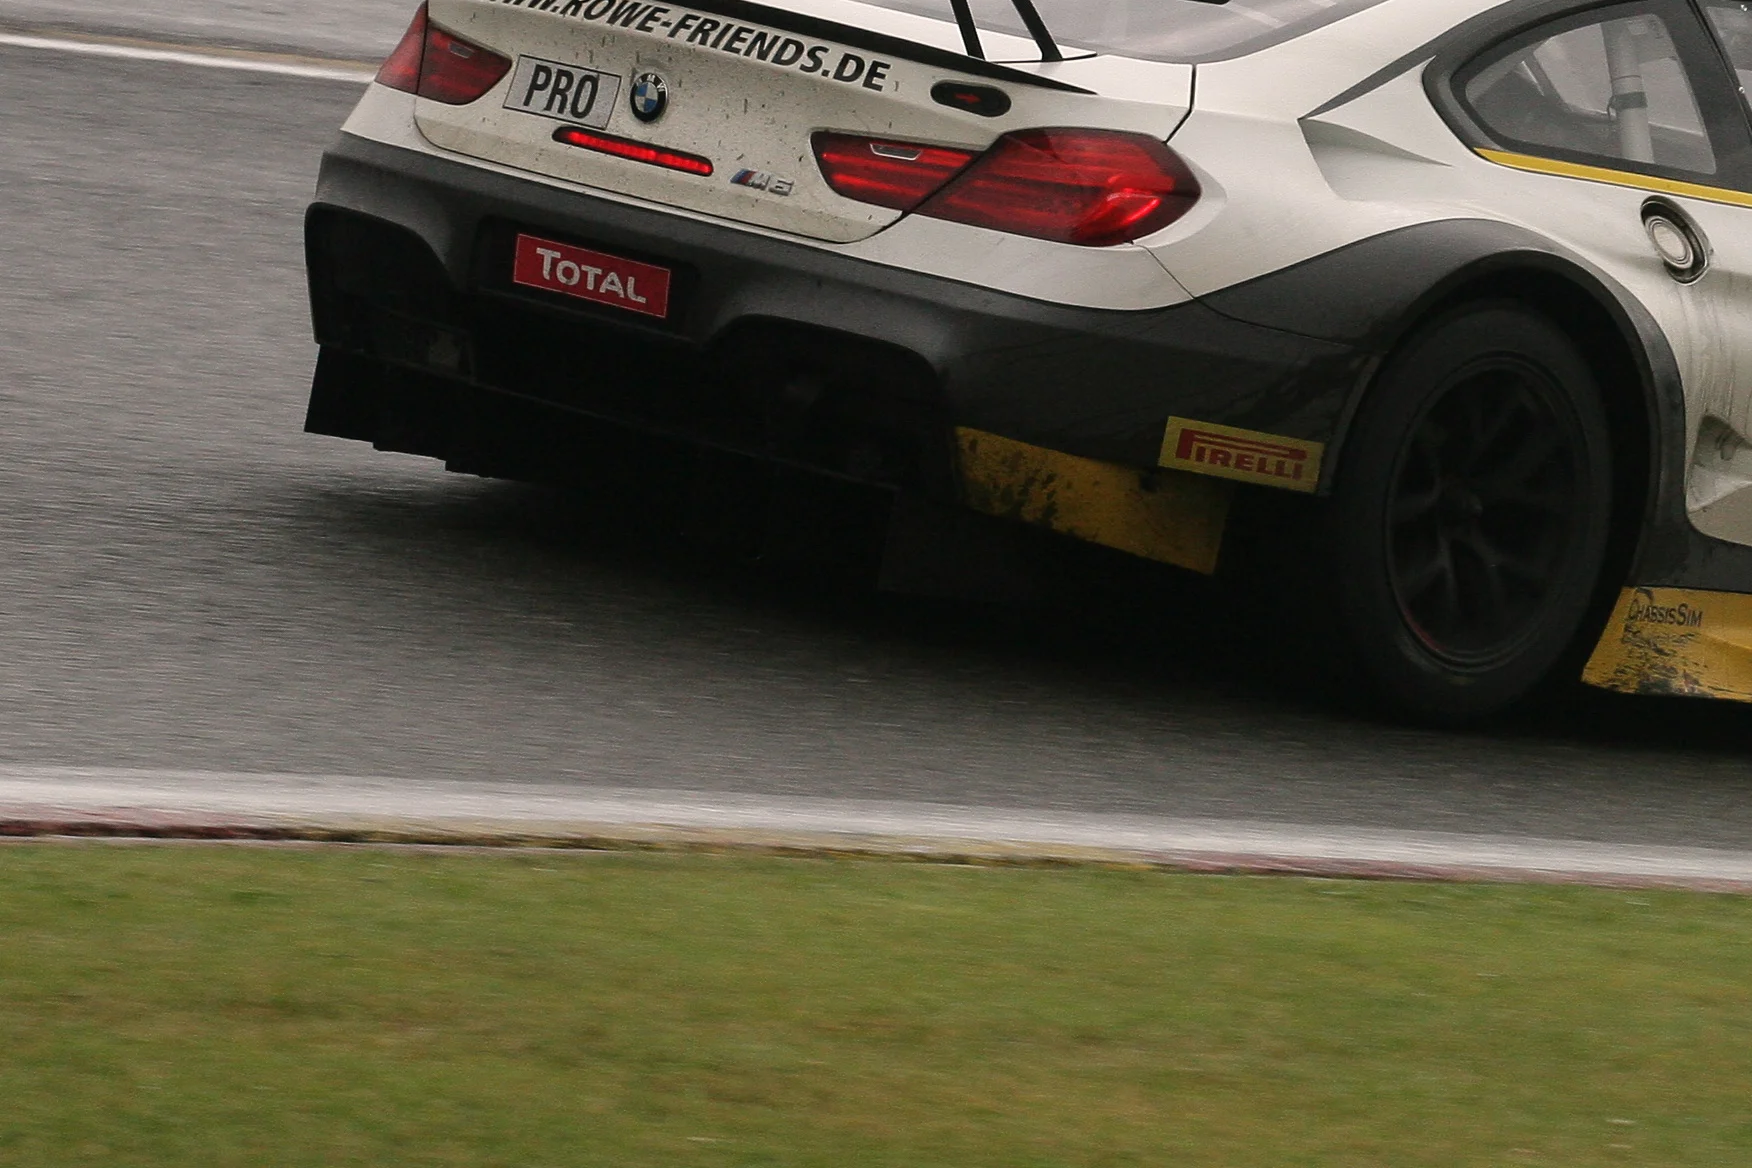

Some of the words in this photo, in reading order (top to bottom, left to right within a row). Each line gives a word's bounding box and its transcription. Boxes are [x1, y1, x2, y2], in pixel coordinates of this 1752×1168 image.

[522, 63, 600, 119] PRO
[737, 169, 795, 197] M6
[536, 245, 649, 308] TOTAL
[1175, 427, 1308, 480] PIRELLI
